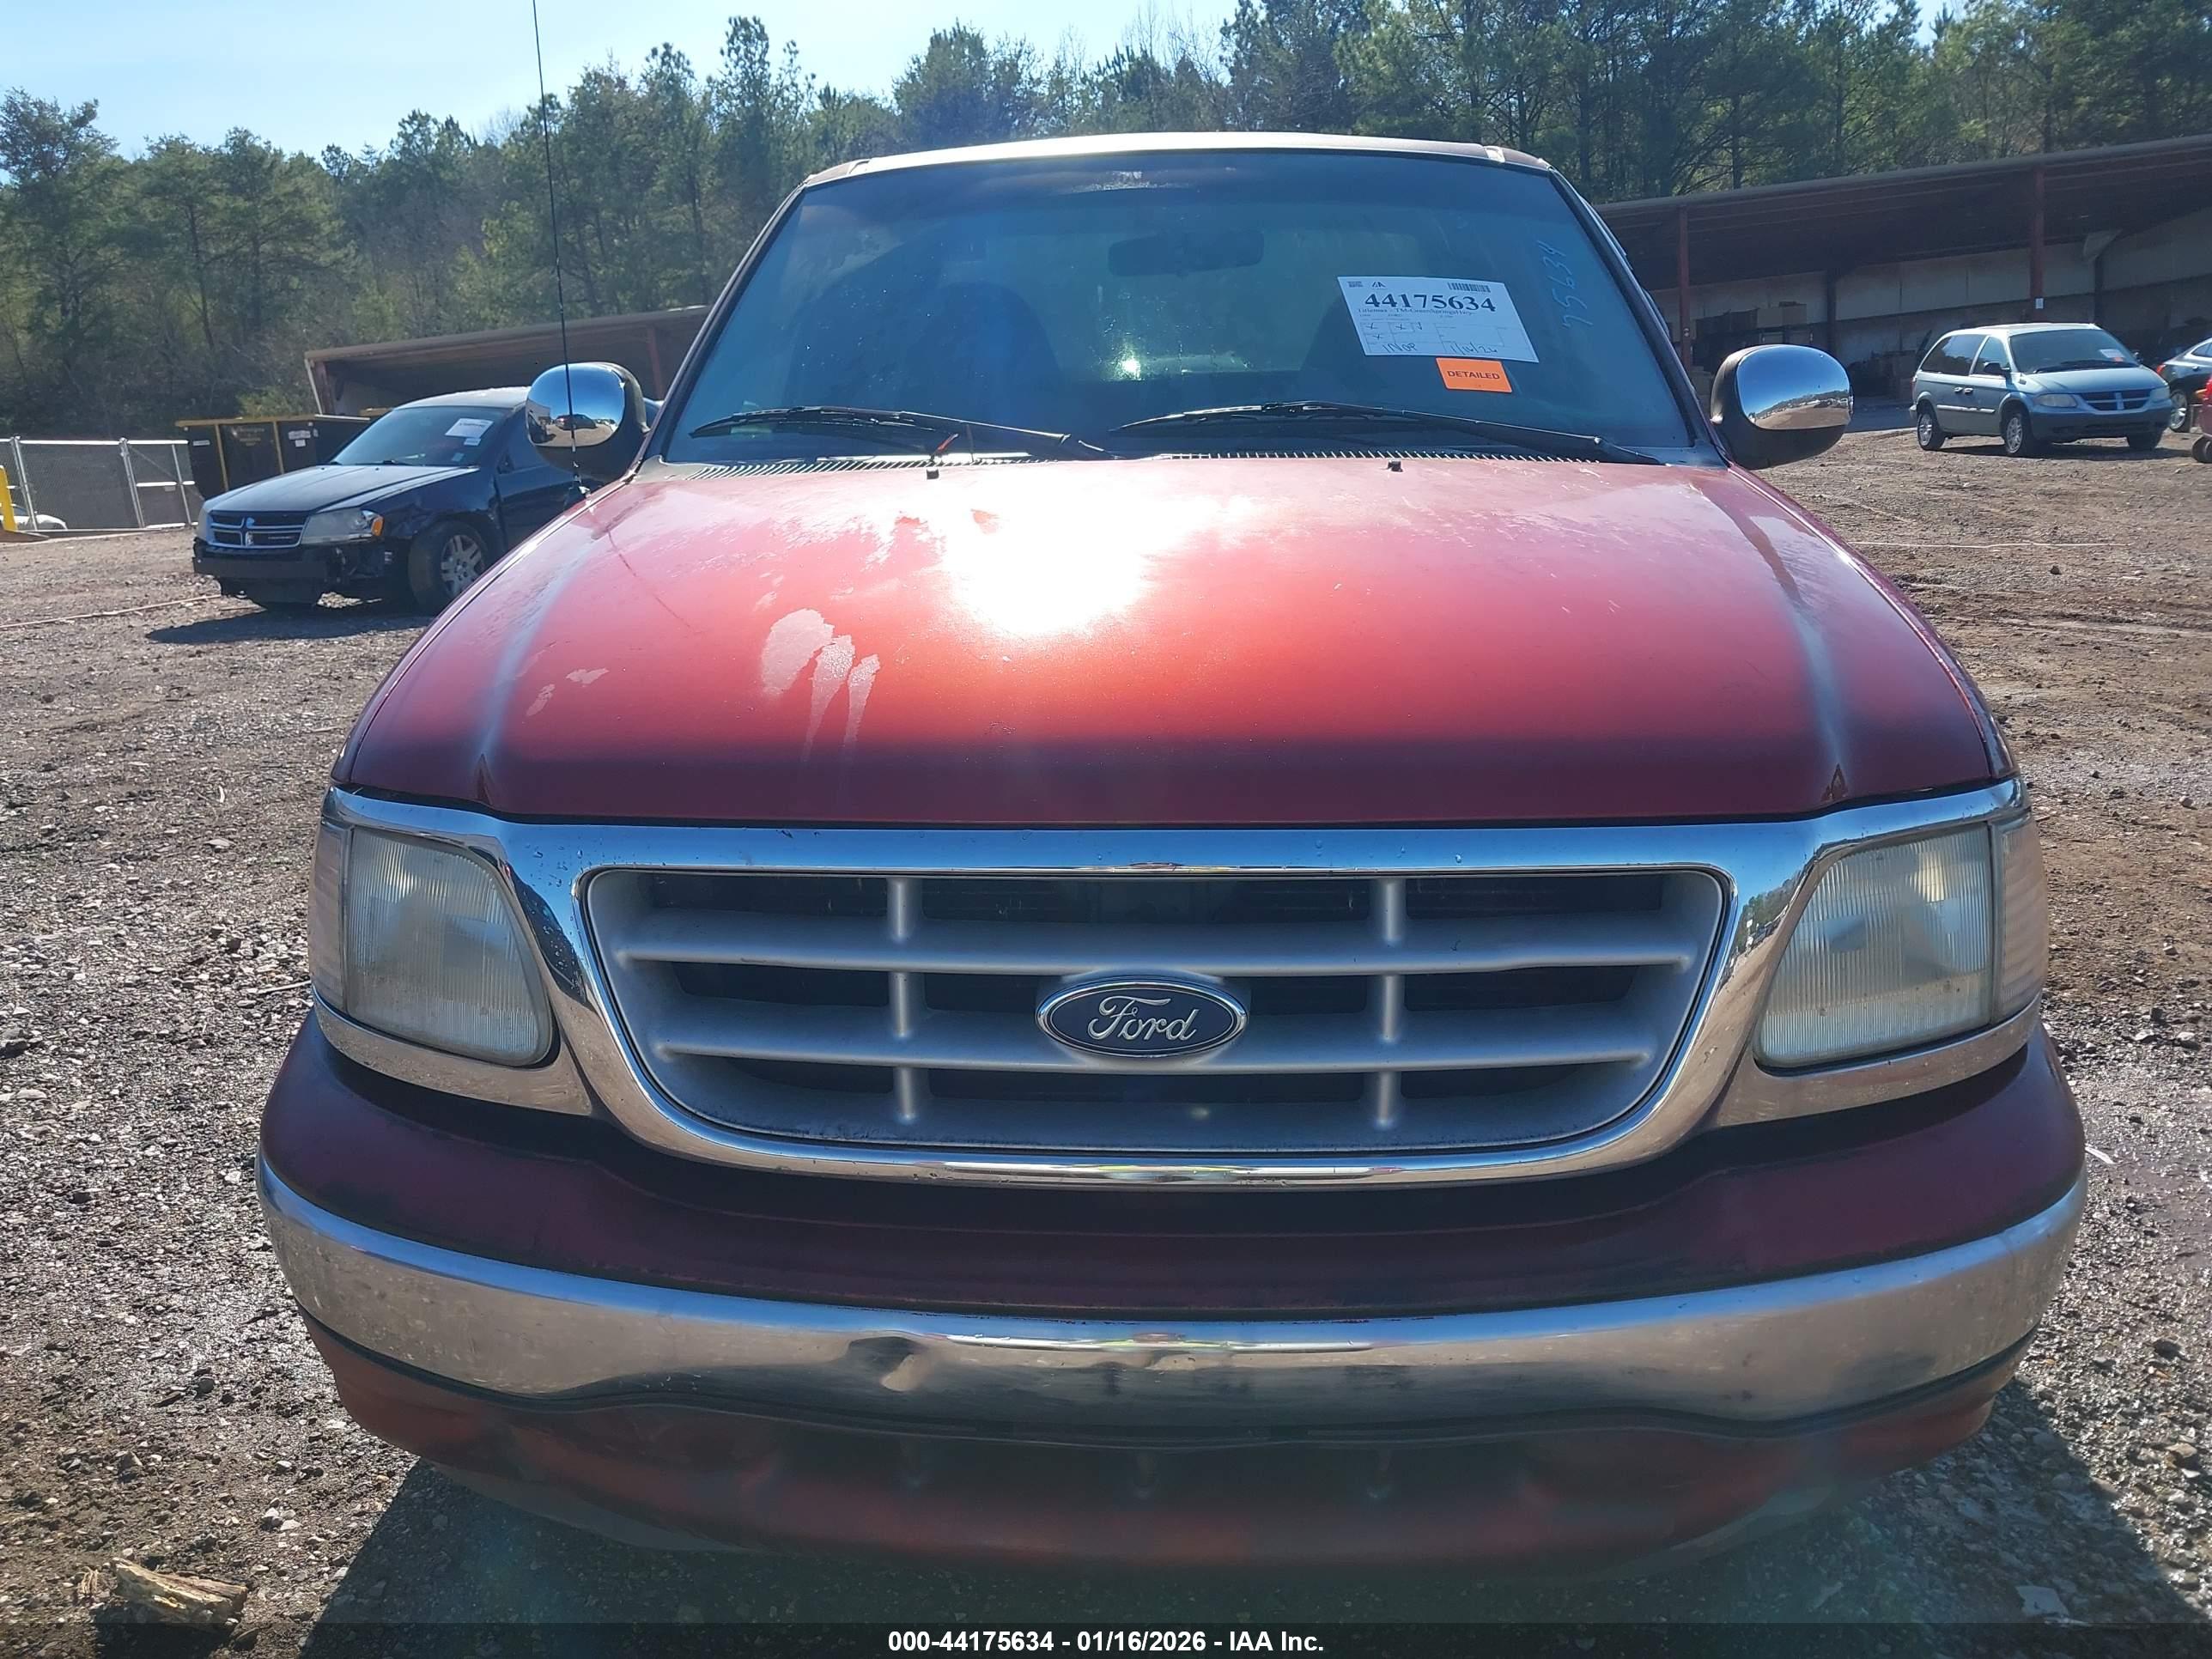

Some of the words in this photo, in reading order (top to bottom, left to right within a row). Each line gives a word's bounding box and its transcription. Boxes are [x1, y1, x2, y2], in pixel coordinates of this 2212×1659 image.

[1364, 293, 1497, 313] 44175634
[1447, 370, 1501, 380] DETAILED
[1087, 995, 1200, 1041] Ford
